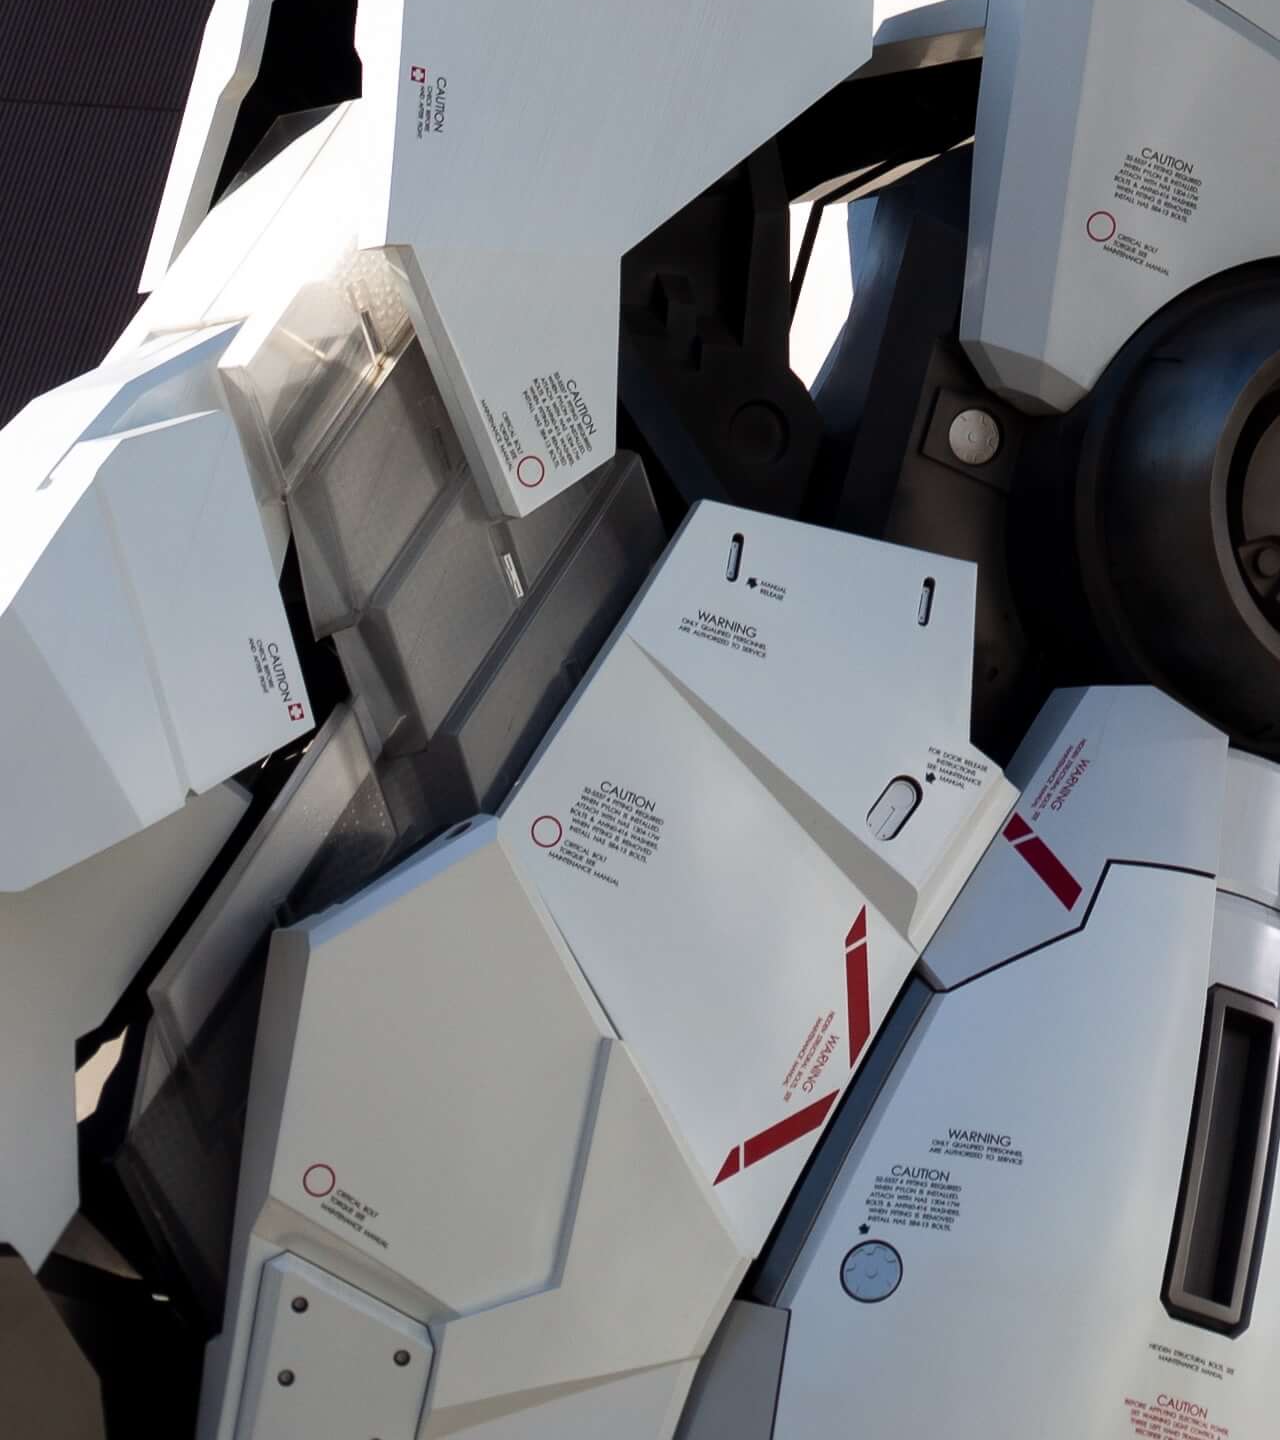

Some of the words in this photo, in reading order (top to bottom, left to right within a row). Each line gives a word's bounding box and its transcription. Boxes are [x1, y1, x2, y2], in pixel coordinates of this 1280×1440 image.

[433, 76, 446, 133] CAUTION
[1140, 147, 1194, 174] CAUTION
[565, 378, 596, 435] CAUTION
[697, 609, 756, 638] WARNING
[267, 642, 292, 702] CAUTION
[599, 780, 656, 812] CAUTION
[1050, 759, 1090, 810] WARNING
[801, 1034, 839, 1093] WARNING
[948, 1128, 1011, 1147] WARNING
[890, 1164, 950, 1182] CAUTION
[1156, 1394, 1208, 1418] CAUTION
